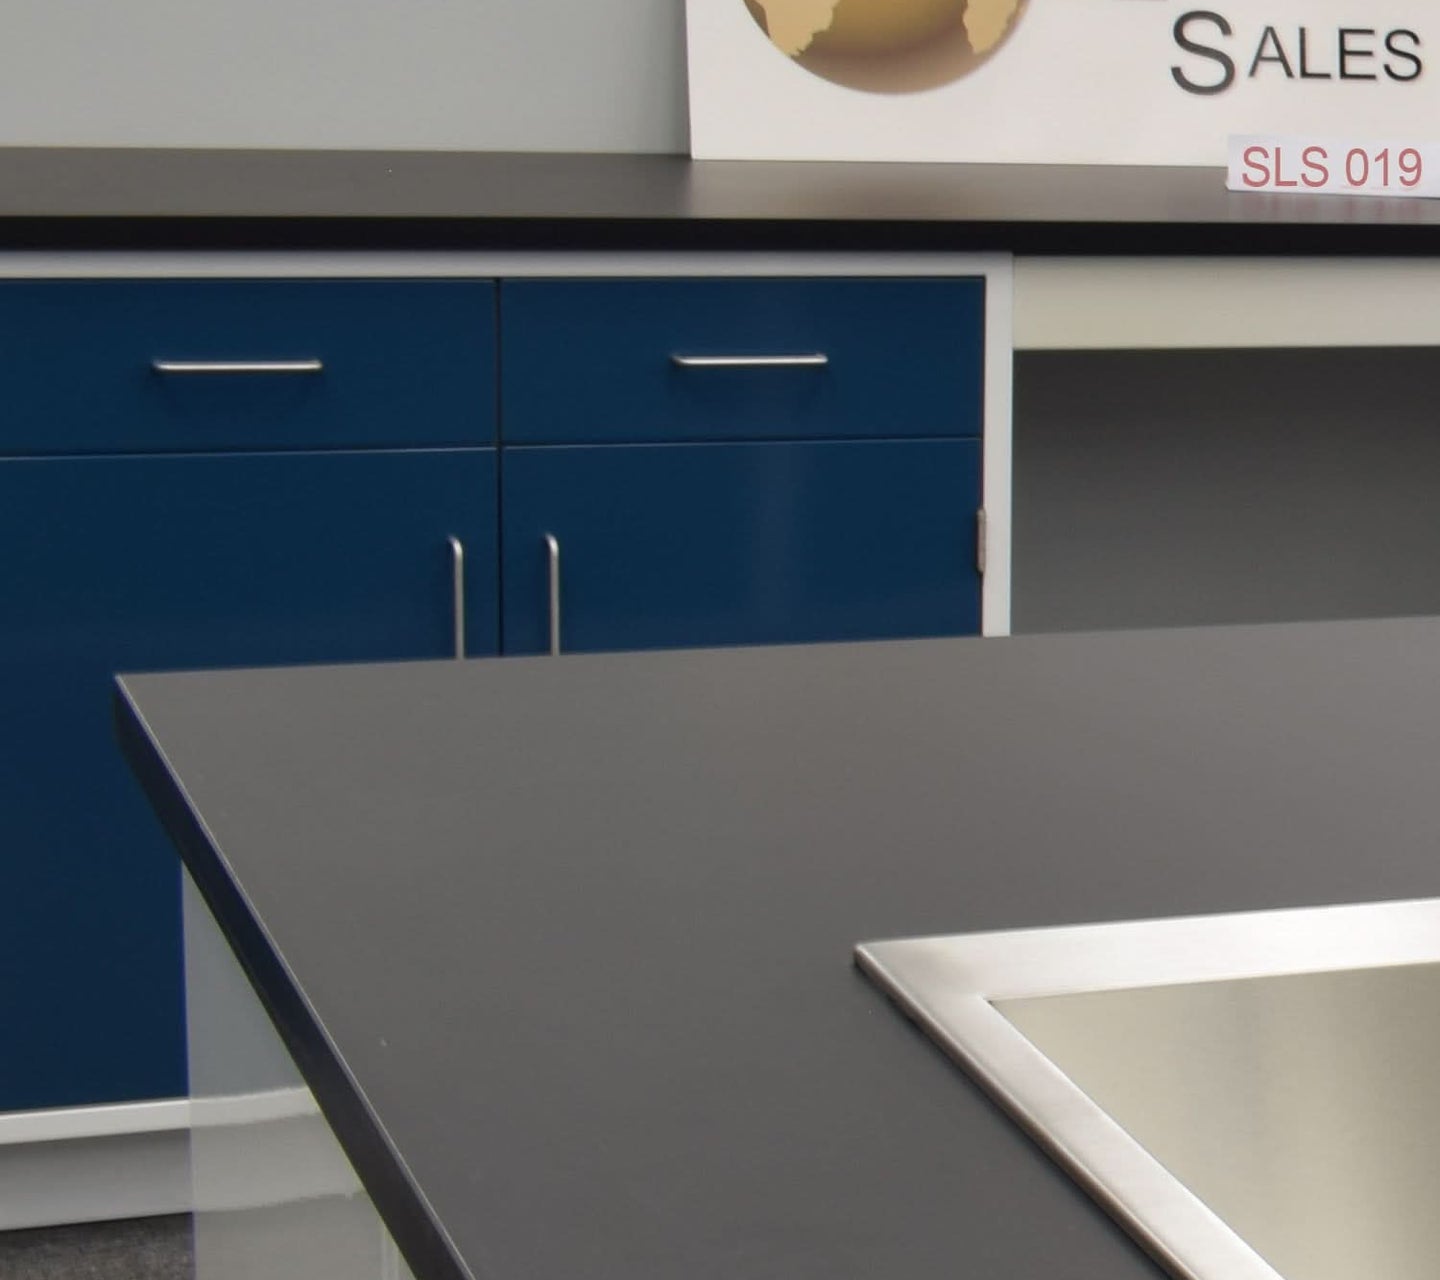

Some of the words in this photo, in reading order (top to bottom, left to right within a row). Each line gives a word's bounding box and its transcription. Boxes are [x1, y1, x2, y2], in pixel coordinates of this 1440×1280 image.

[1169, 9, 1425, 97] SALES
[1241, 145, 1330, 189] SLS
[1344, 146, 1424, 189] 019
